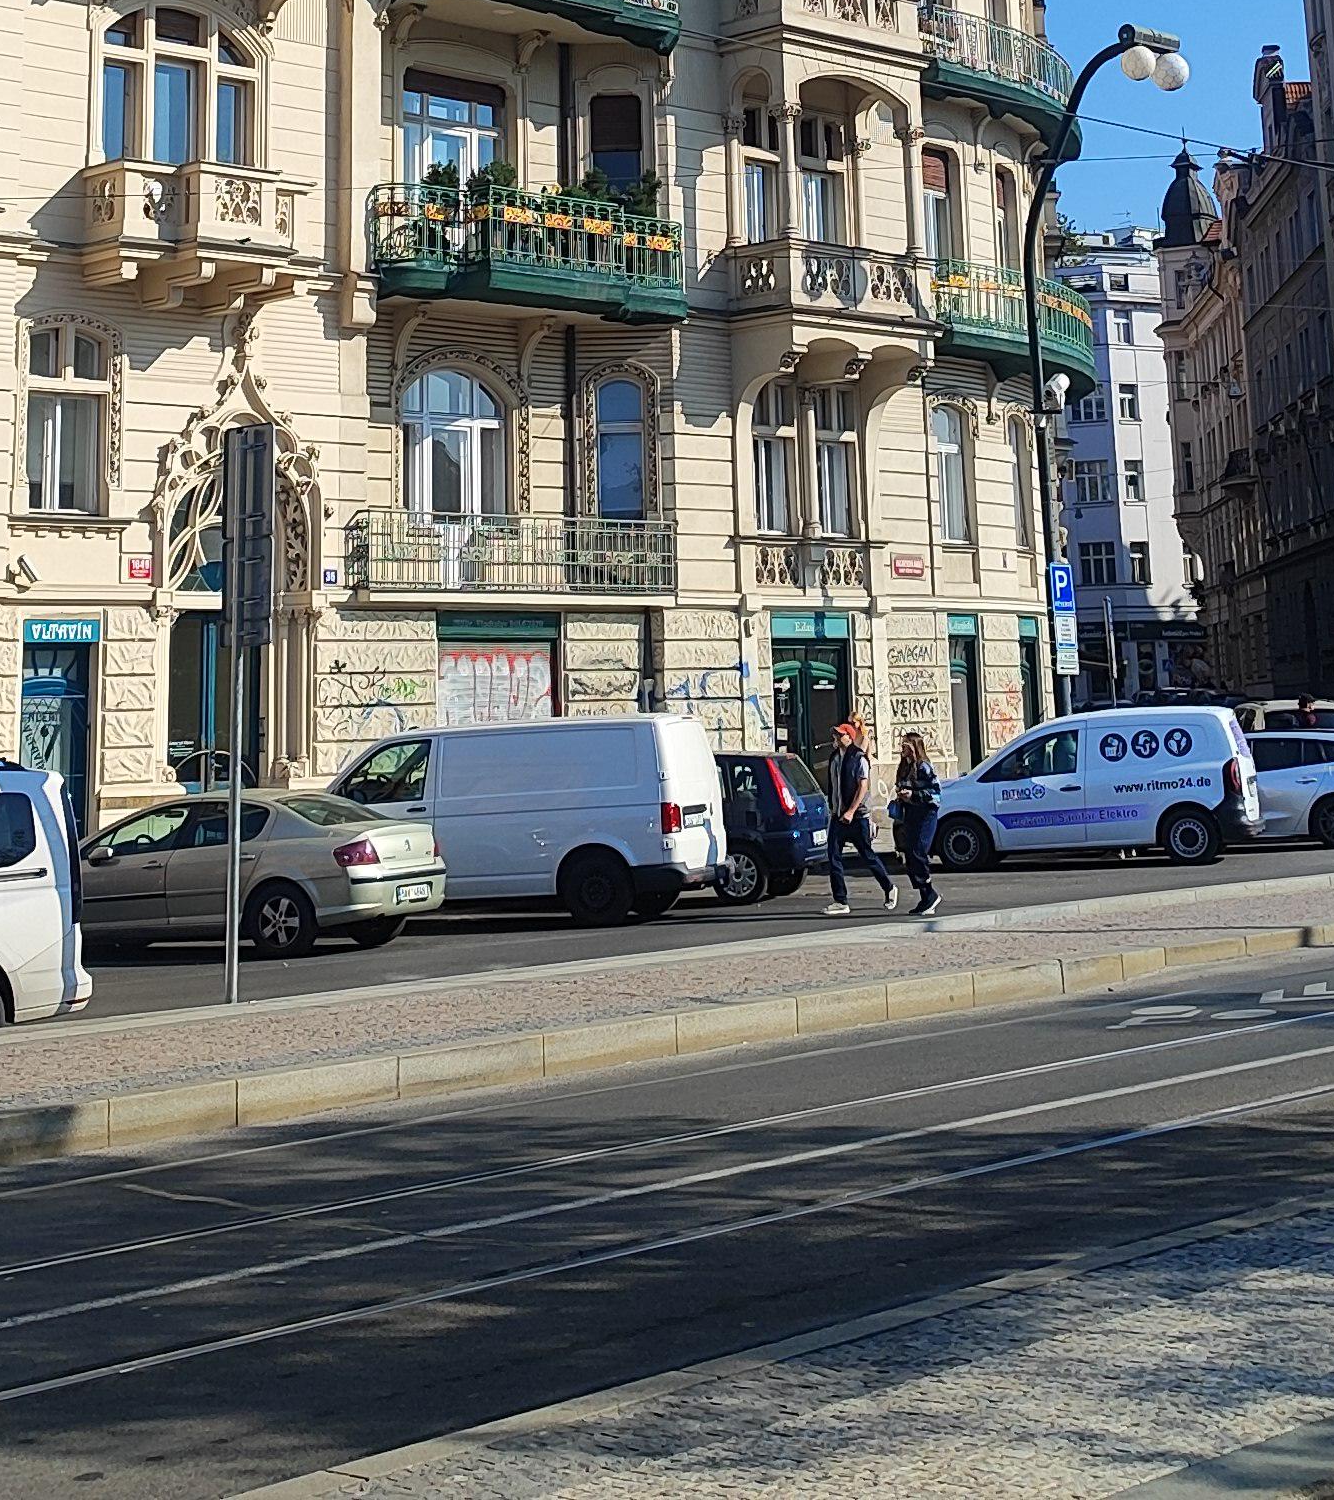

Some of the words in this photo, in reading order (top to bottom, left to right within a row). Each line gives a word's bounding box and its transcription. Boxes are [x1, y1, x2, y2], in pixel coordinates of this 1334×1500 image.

[1054, 569, 1068, 599] P
[31, 621, 93, 641] VLTAVÍN
[1112, 776, 1212, 794] www.ritmo24.de
[1099, 808, 1138, 820] Elektro
